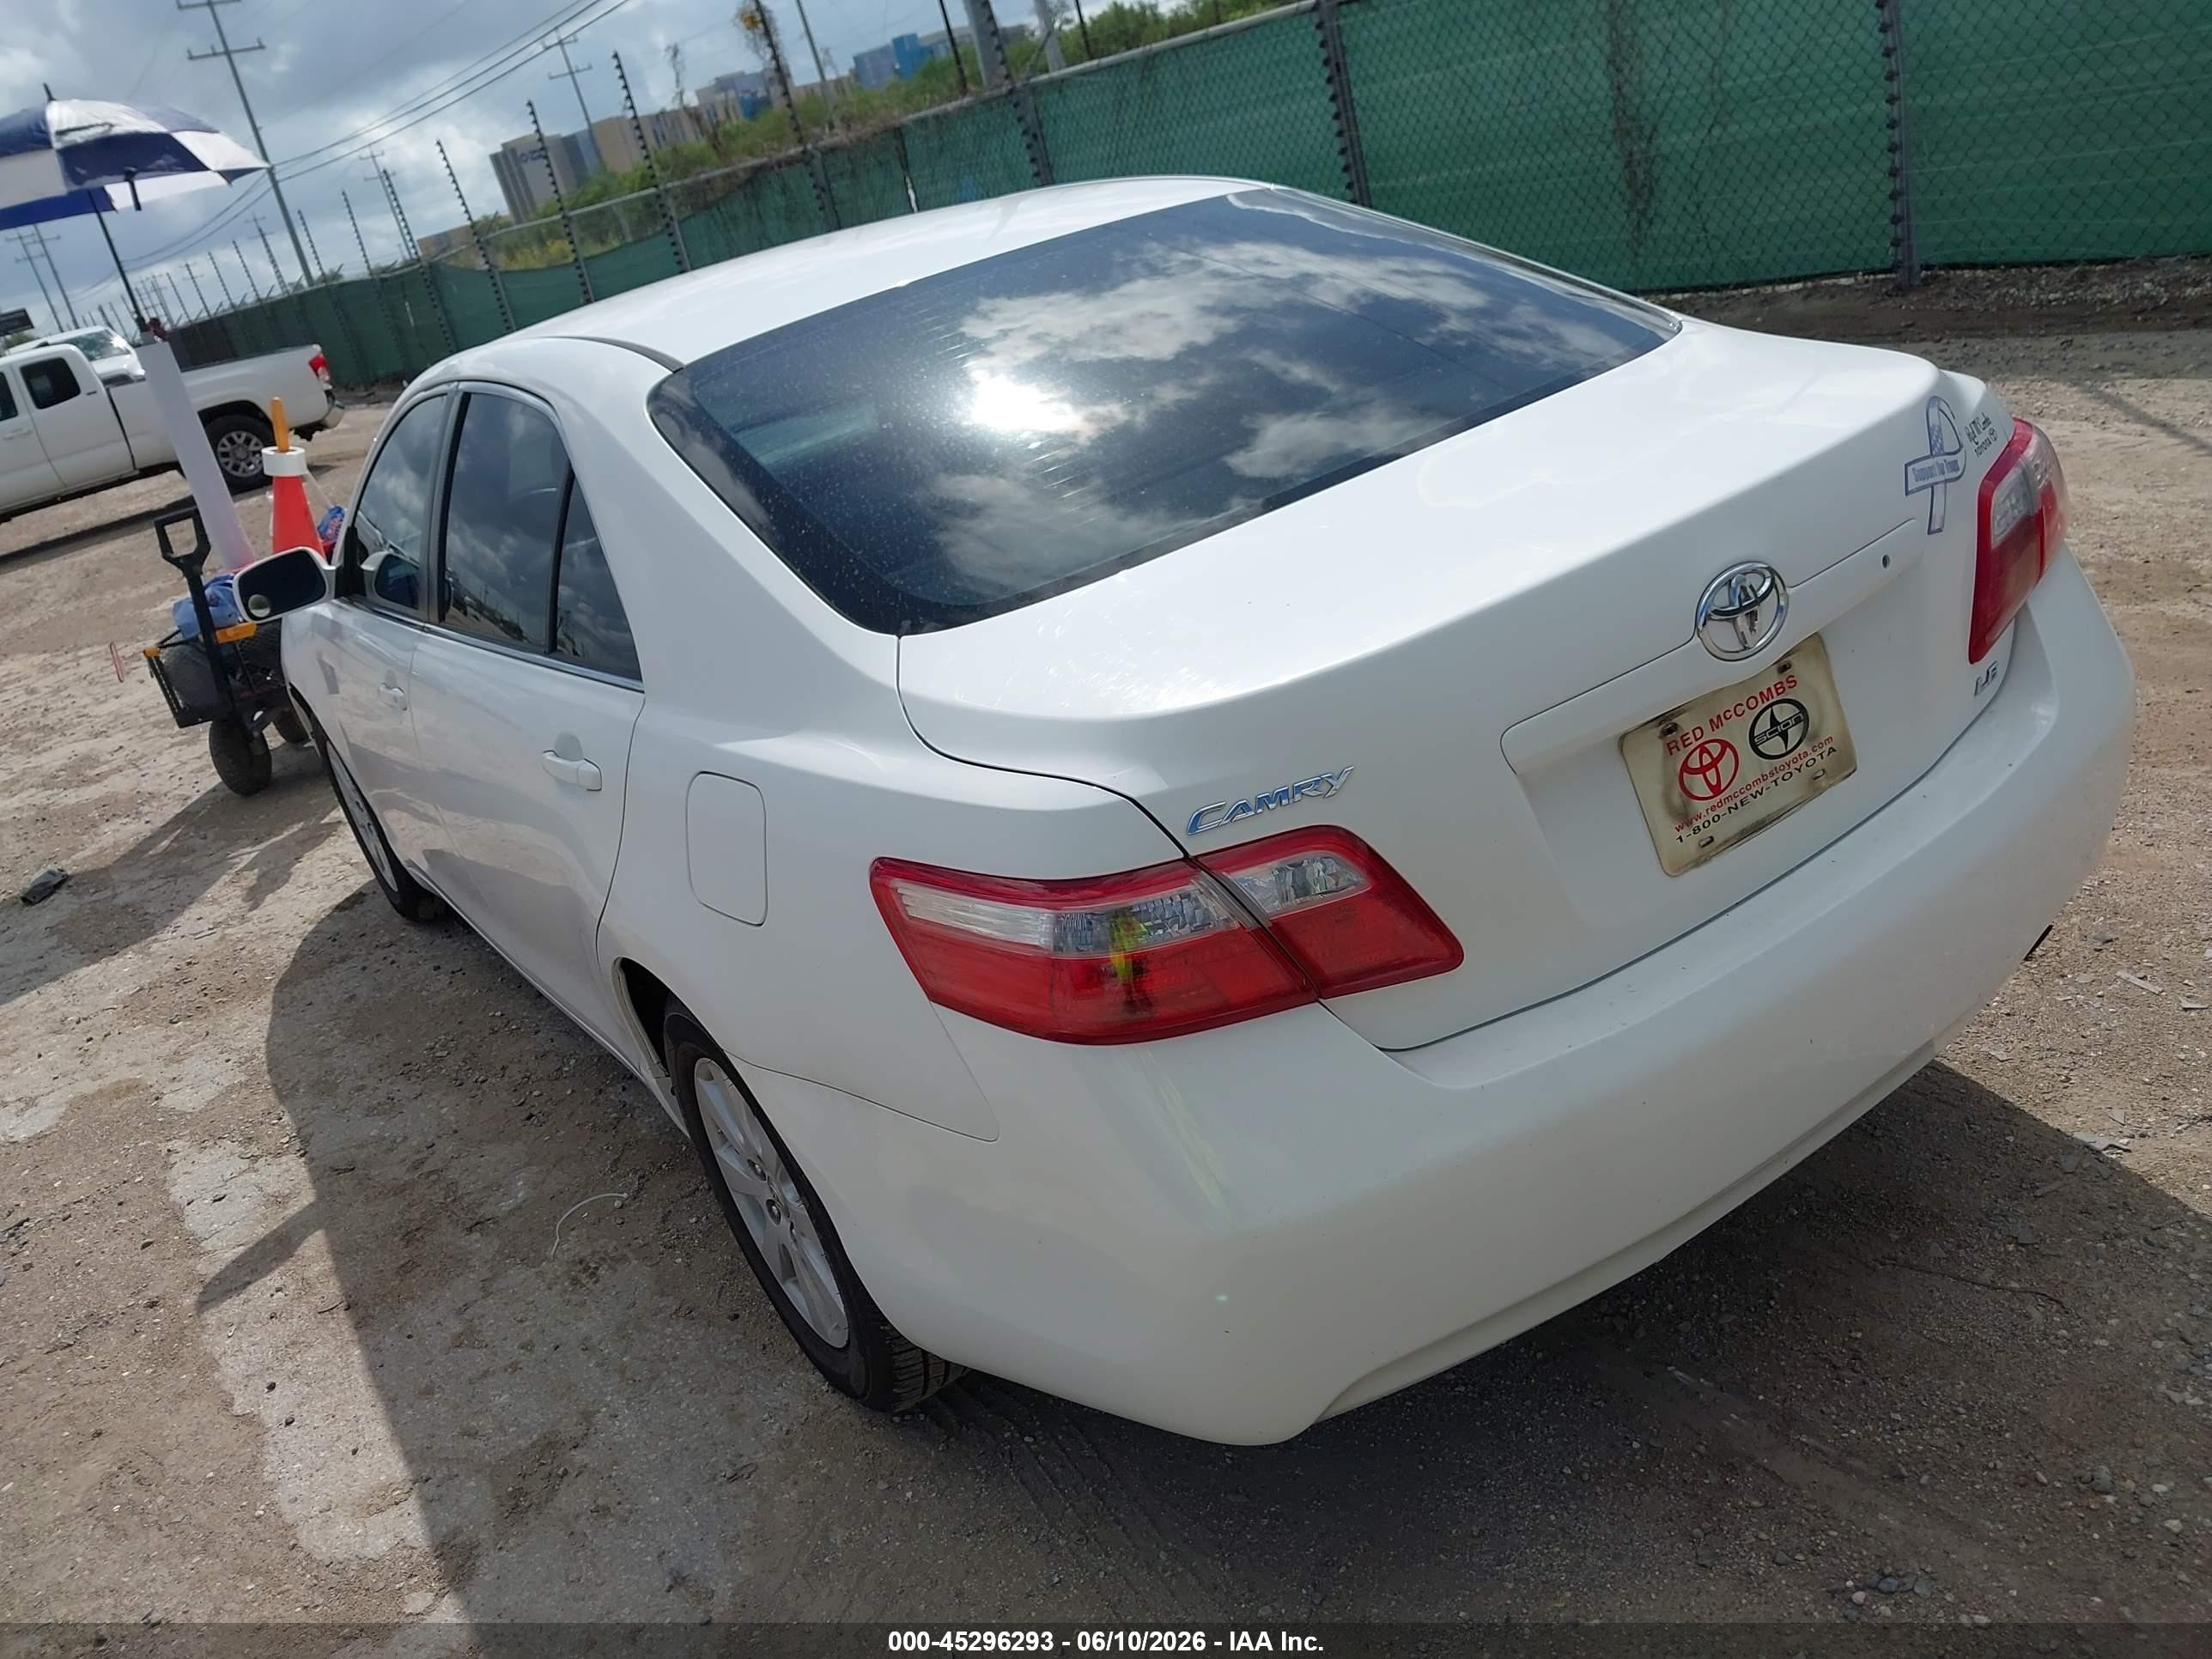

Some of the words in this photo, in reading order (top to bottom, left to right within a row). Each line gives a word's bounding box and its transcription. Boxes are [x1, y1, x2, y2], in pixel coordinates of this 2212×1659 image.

[1666, 726, 1705, 757] RED
[1708, 674, 1798, 732] McCOMBS
[1186, 765, 1355, 836] CAMRY
[1674, 734, 1834, 833] www.redmccombstoyota.com
[1675, 746, 1838, 844] 1-800-NEW-TOYOTA
